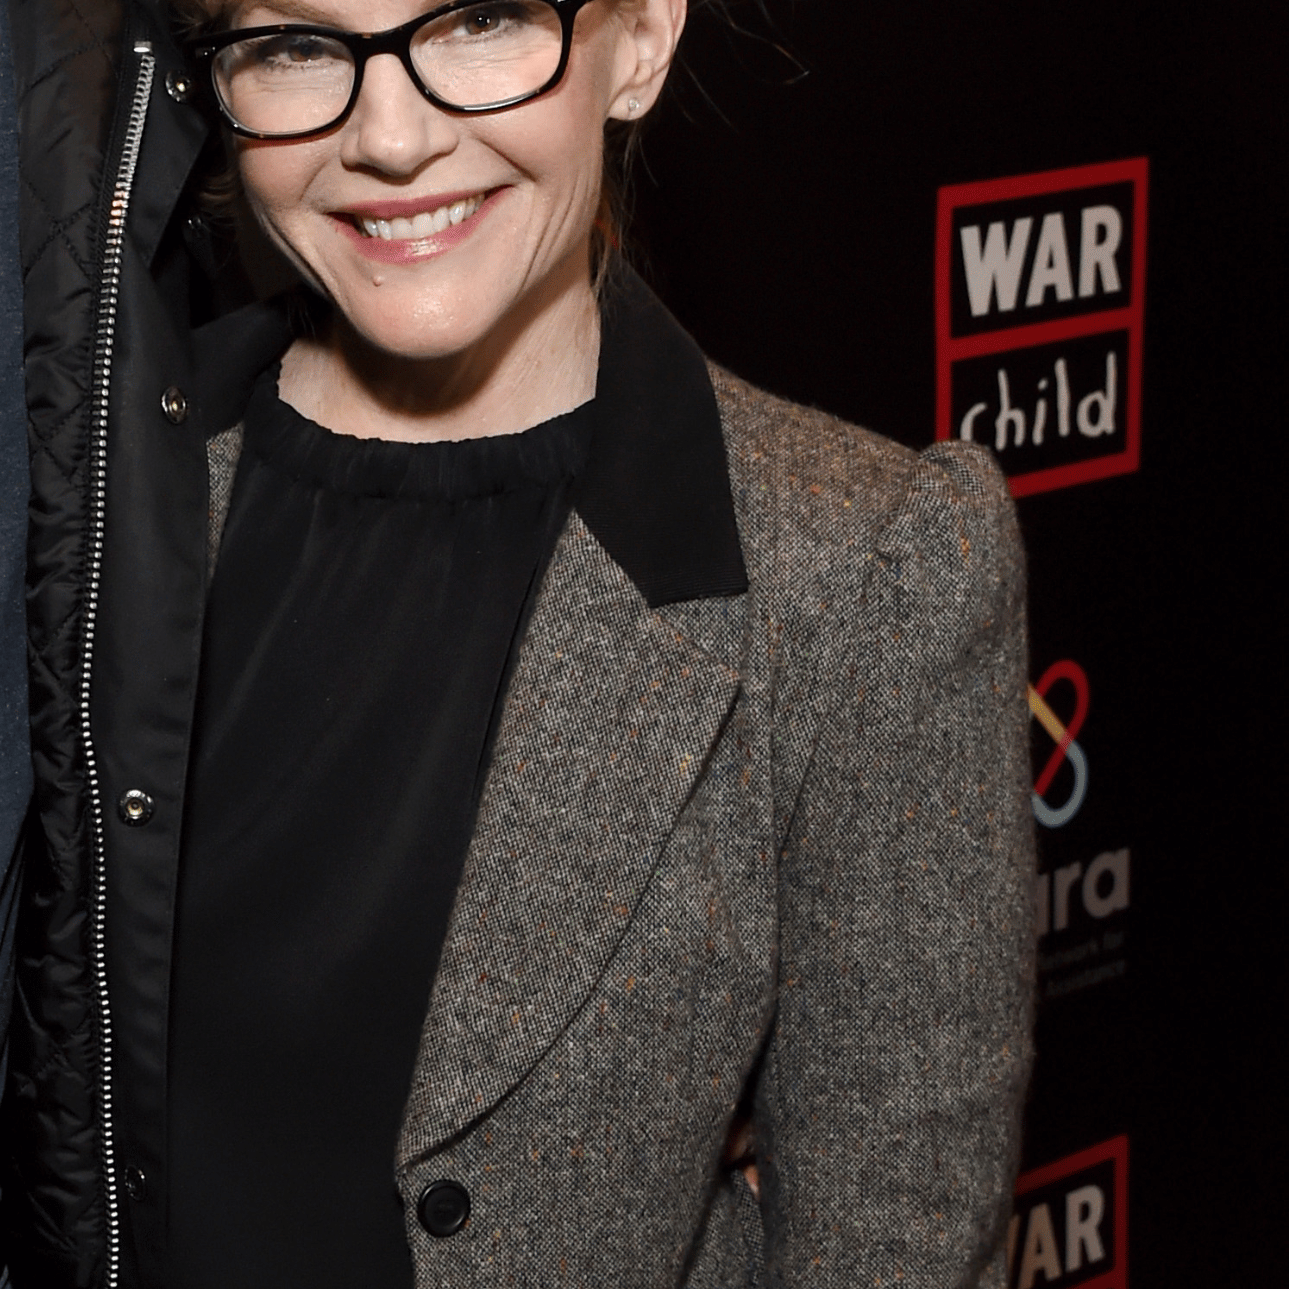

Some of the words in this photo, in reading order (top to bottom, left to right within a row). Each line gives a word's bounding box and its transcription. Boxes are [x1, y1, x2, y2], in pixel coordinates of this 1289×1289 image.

[960, 205, 1123, 317] WAR
[961, 351, 1117, 451] child
[1007, 1184, 1105, 1289] AR
